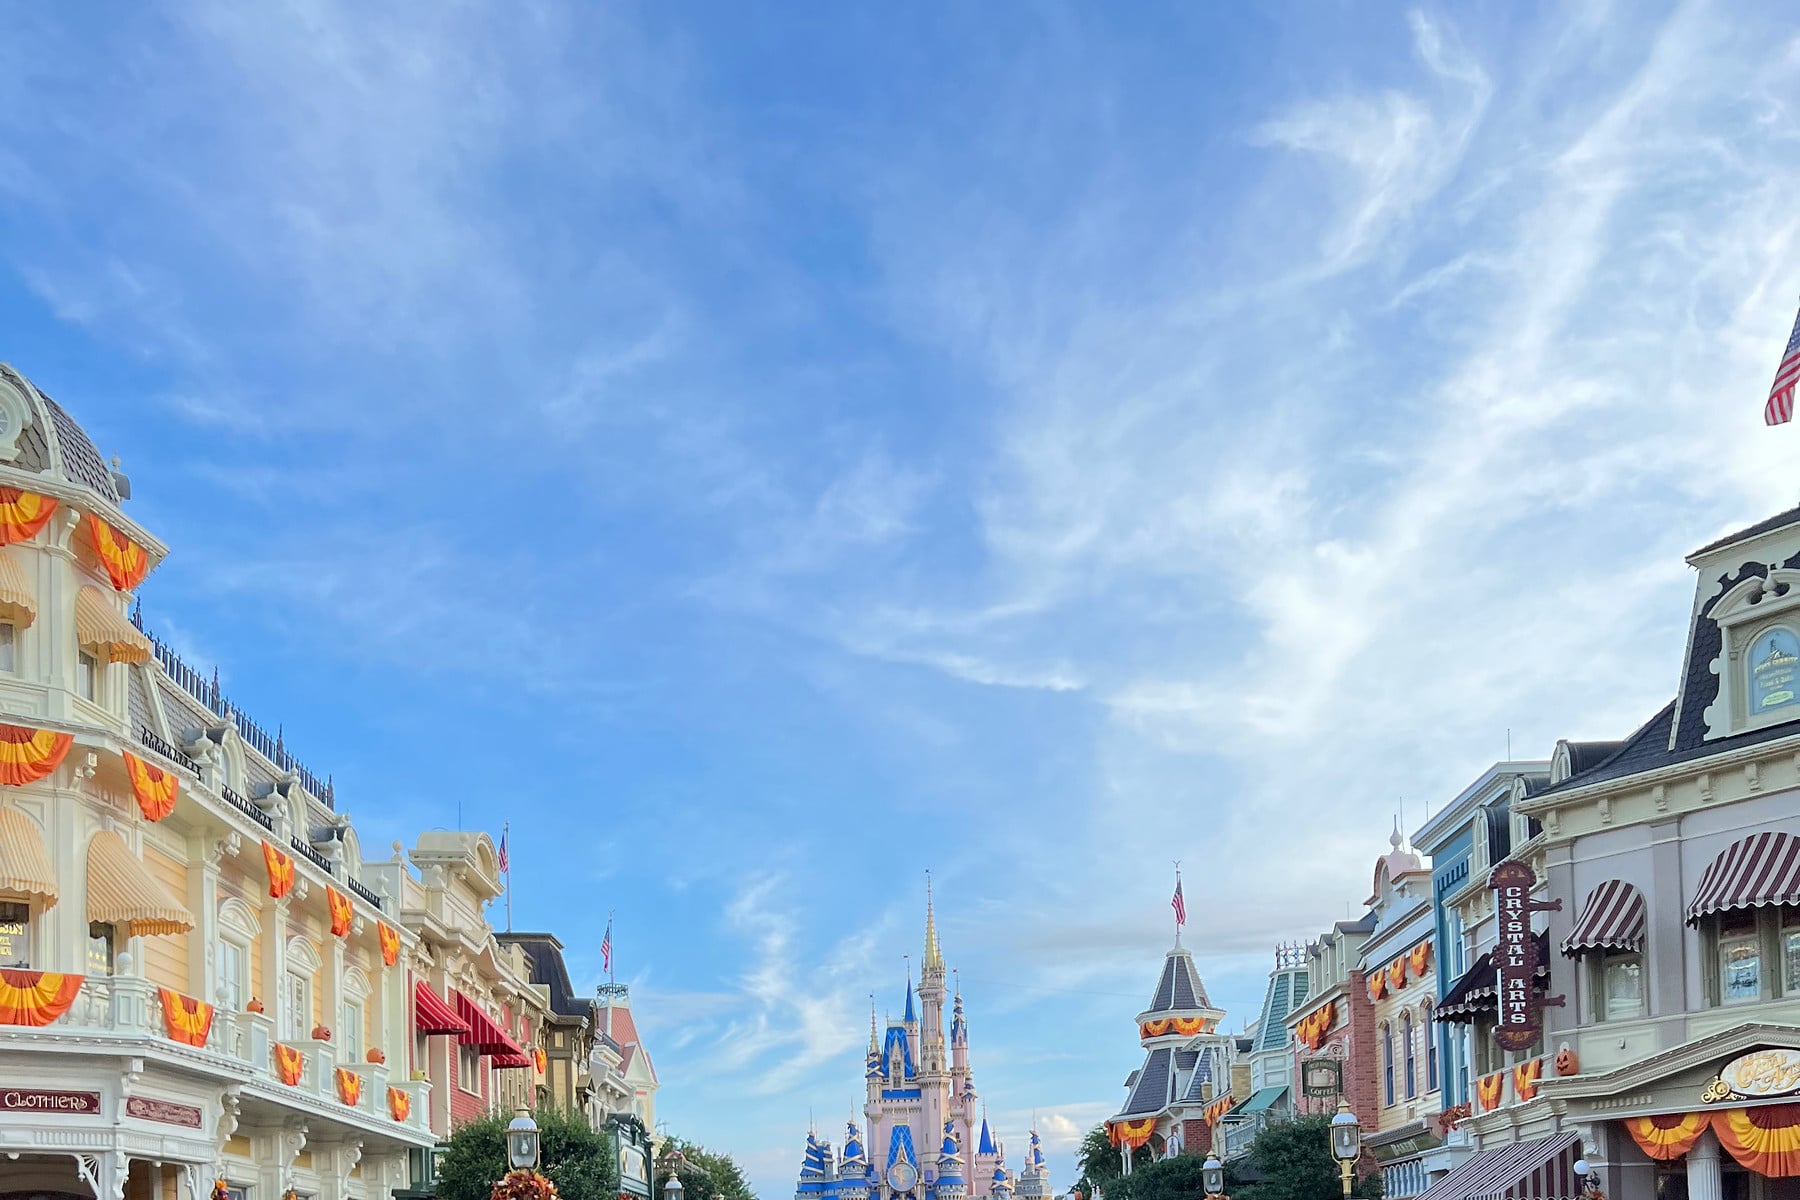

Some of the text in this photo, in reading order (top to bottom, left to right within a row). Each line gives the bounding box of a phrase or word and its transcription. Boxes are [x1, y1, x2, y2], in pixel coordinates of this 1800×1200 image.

[1505, 886, 1526, 1024] CRYSTAL ARTS
[5, 1092, 88, 1110] CLOTHIERS
